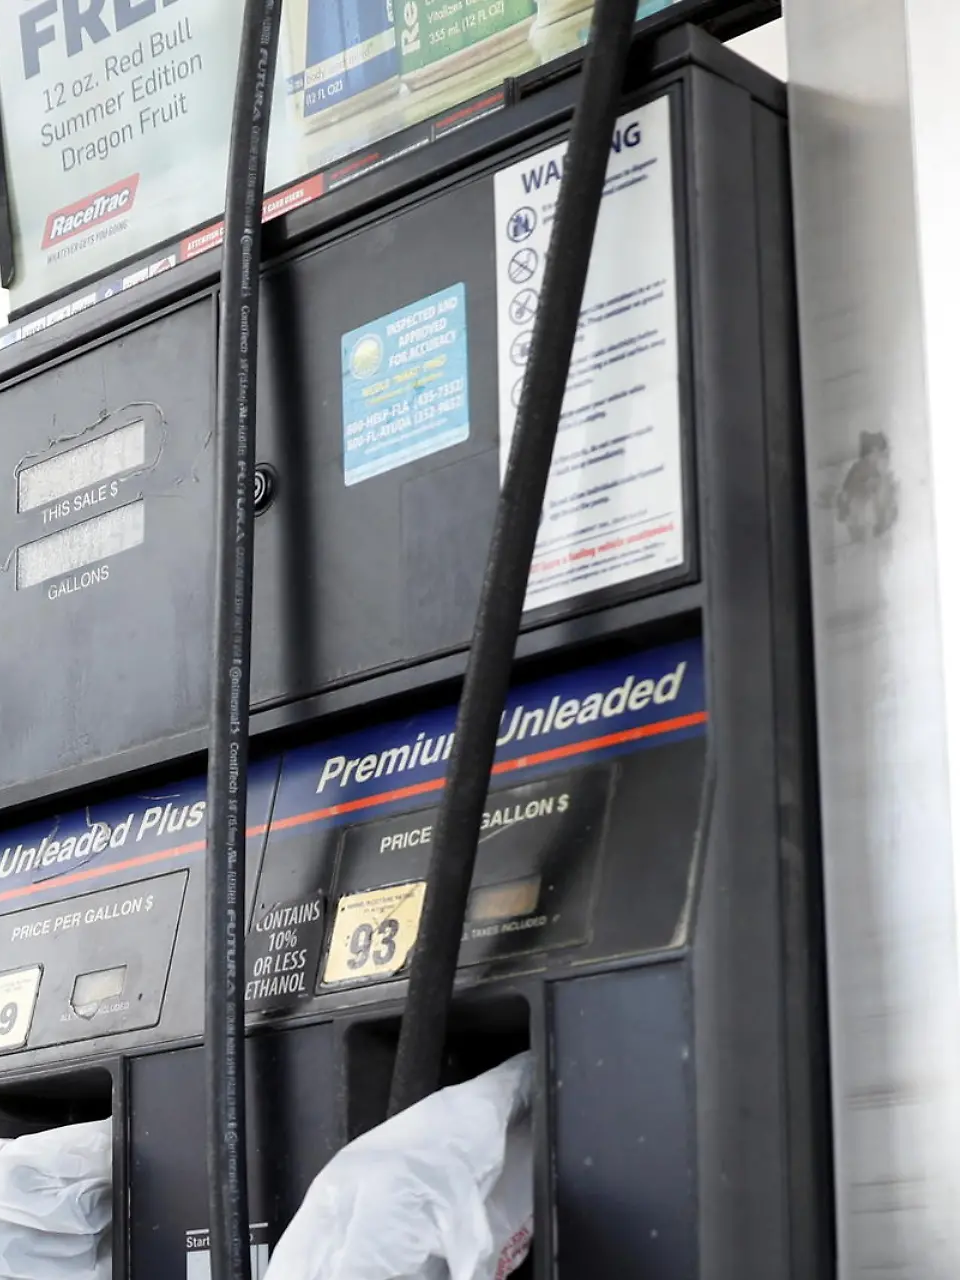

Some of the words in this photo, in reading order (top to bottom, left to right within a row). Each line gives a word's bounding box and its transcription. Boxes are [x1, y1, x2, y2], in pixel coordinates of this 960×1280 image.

[19, 0, 180, 80] FR
[43, 82, 67, 113] 12
[72, 73, 99, 98] oz.
[105, 41, 144, 82] Red
[150, 16, 193, 58] Bull
[41, 90, 125, 147] Summer
[132, 53, 203, 103] Edition
[62, 124, 133, 172] Dragon
[140, 93, 188, 134] Fruit
[521, 122, 641, 194] WANG
[50, 188, 130, 240] RaceTrac
[41, 500, 70, 525] THIS
[74, 485, 107, 511] SALE
[48, 564, 110, 601] GALLONS
[315, 731, 454, 795] Premiu
[495, 661, 688, 747] Unleaded
[229, 742, 240, 794] ContiTech
[136, 800, 207, 842] Plus
[380, 825, 433, 854] PRICE
[480, 796, 556, 831] GALLON
[11, 919, 51, 942] PRICE
[53, 911, 82, 933] PER
[84, 898, 143, 925] GALLON
[144, 894, 155, 912] $
[268, 928, 299, 952] 10%
[346, 917, 400, 971] 93
[244, 972, 307, 1002] ETHANOL
[253, 955, 271, 978] OR
[274, 948, 308, 974] LESS
[186, 1235, 211, 1249] Start
